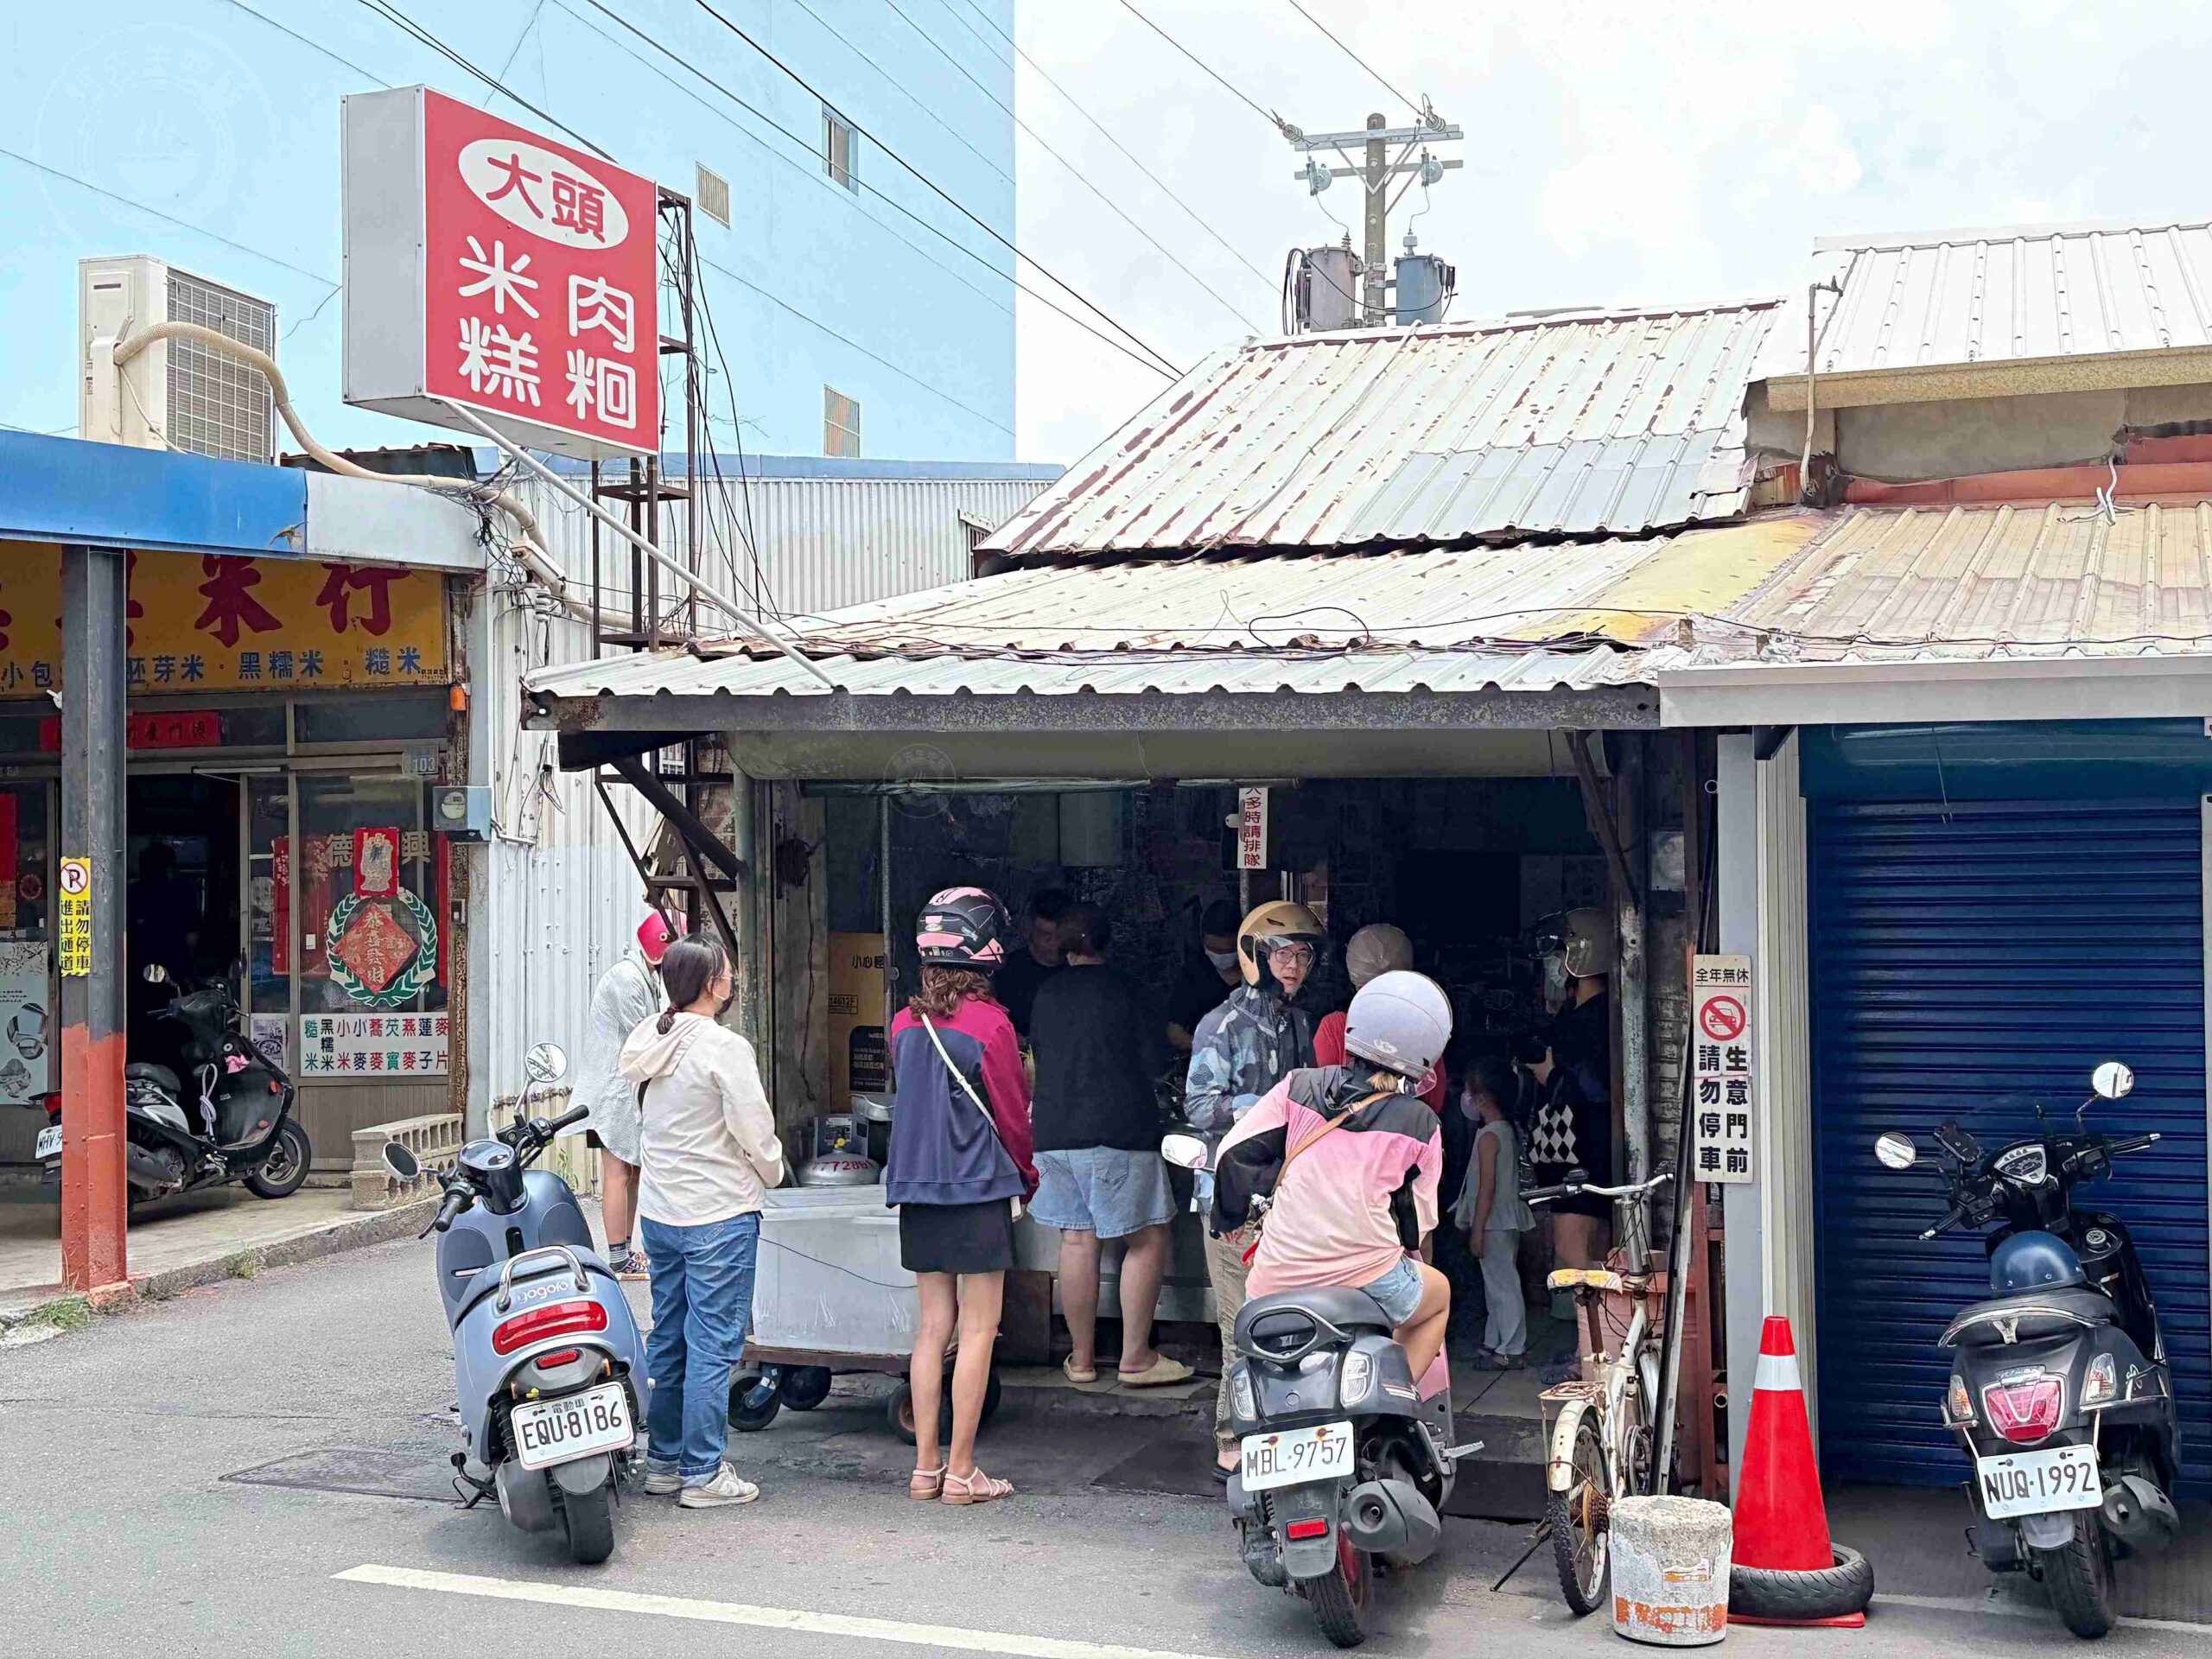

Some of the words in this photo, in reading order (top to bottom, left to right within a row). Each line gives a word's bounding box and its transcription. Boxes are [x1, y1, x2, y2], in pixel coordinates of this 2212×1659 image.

[486, 153, 606, 245] 大頭
[458, 235, 541, 407] 米糕
[238, 650, 323, 679] 黑糯米
[365, 646, 421, 677] 糙米
[413, 757, 435, 772] 103
[75, 899, 90, 970] 請勿停車
[1695, 969, 1749, 983] 全年無休
[1699, 1045, 1720, 1173] 請勿停車
[1726, 1046, 1748, 1173] 生意門前
[38, 1132, 63, 1152] MHV-9
[518, 1281, 569, 1304] gogoro
